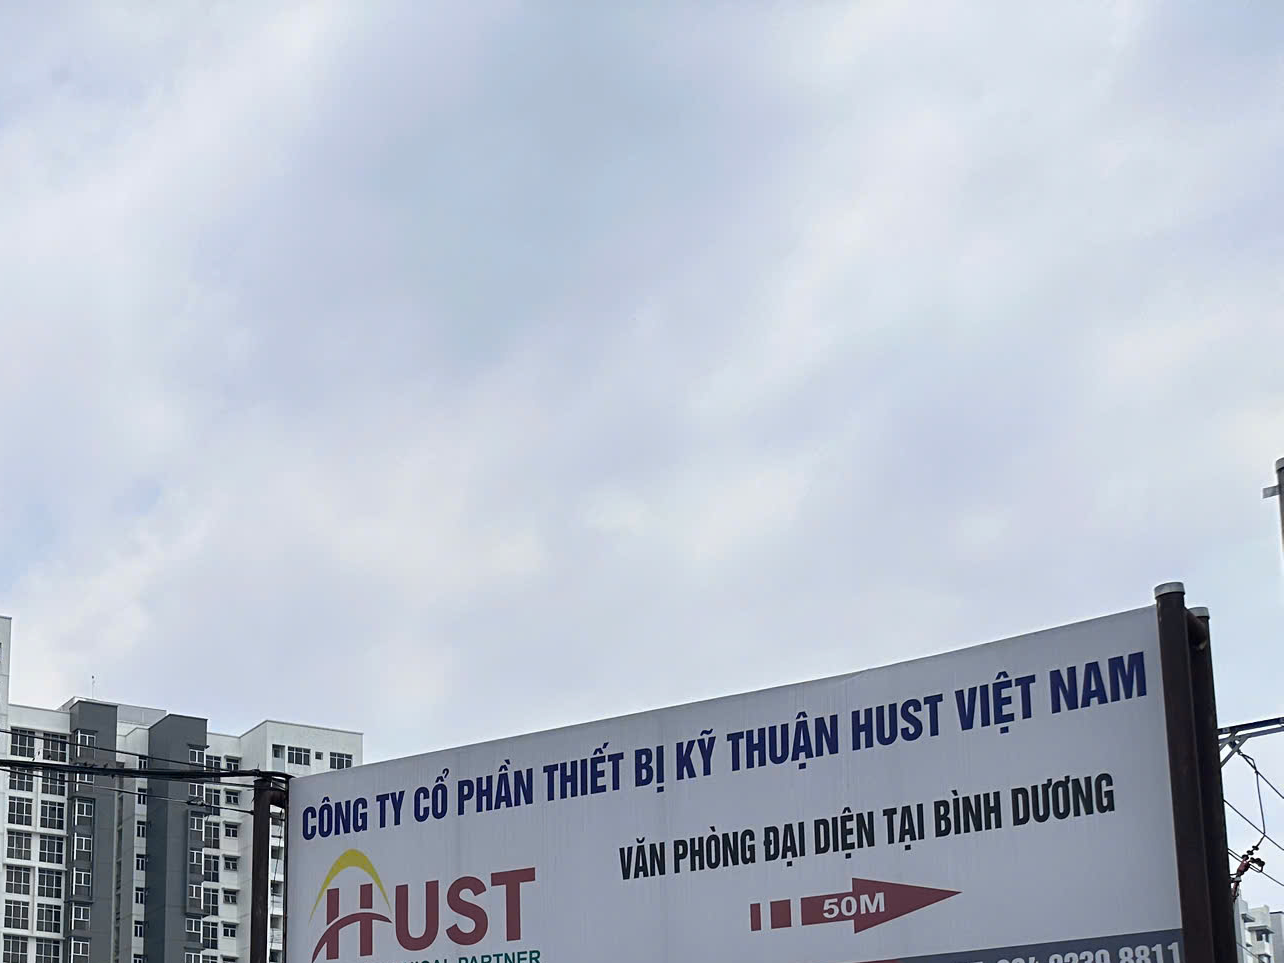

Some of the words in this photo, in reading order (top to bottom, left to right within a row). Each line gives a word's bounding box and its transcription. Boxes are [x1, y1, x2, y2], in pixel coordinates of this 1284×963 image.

[302, 796, 368, 841] CÔNG
[376, 790, 406, 829] TY
[414, 768, 450, 823] CỔ
[457, 759, 534, 816] PHẦN
[543, 742, 624, 801] THIẾT
[634, 745, 665, 793] BỊ
[676, 728, 717, 781] KỸ
[726, 711, 839, 772] THUẬN
[851, 693, 944, 751] HUST
[954, 671, 1036, 734] VIỆT
[1049, 651, 1148, 714] NAM
[619, 837, 666, 880] VĂN
[673, 826, 756, 874] PHÒNG
[763, 821, 806, 867] ĐẠI
[814, 807, 875, 859] DIỆN
[882, 803, 925, 851] TẠI
[933, 789, 1003, 838] BÌNH
[1011, 772, 1116, 826] DƯƠNG
[822, 891, 886, 920] 50M
